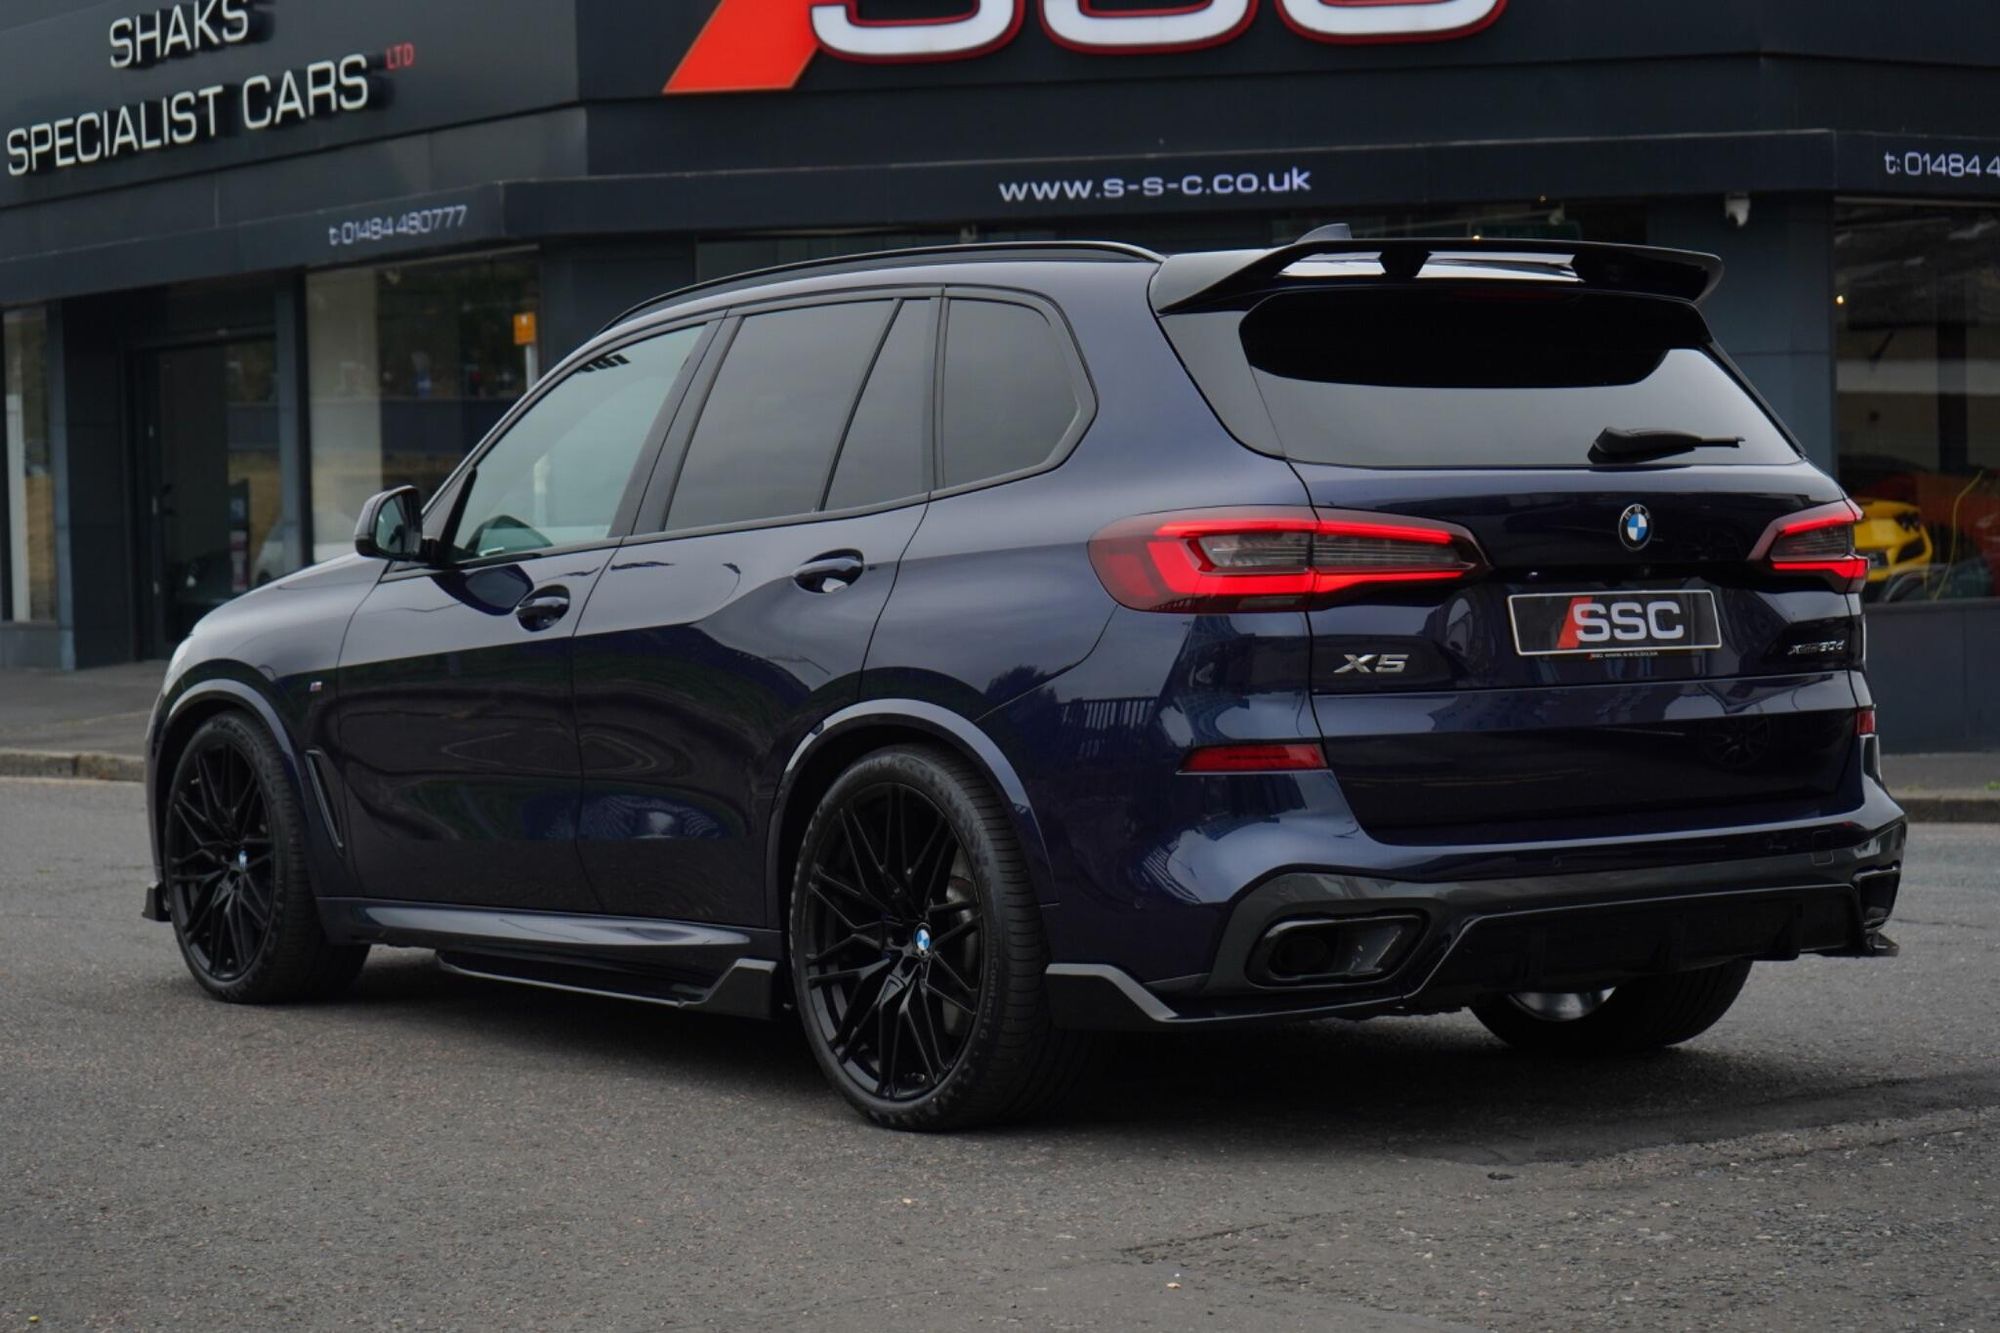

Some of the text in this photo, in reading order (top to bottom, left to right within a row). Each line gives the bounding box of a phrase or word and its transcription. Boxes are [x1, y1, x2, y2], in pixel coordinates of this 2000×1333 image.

[110, 0, 250, 68] SHAKS
[7, 43, 414, 176] SPECIALIST CARS LTD
[999, 167, 1311, 202] www.s-s-c.co.uk
[1573, 601, 1685, 642] SSC
[1333, 653, 1409, 673] X5
